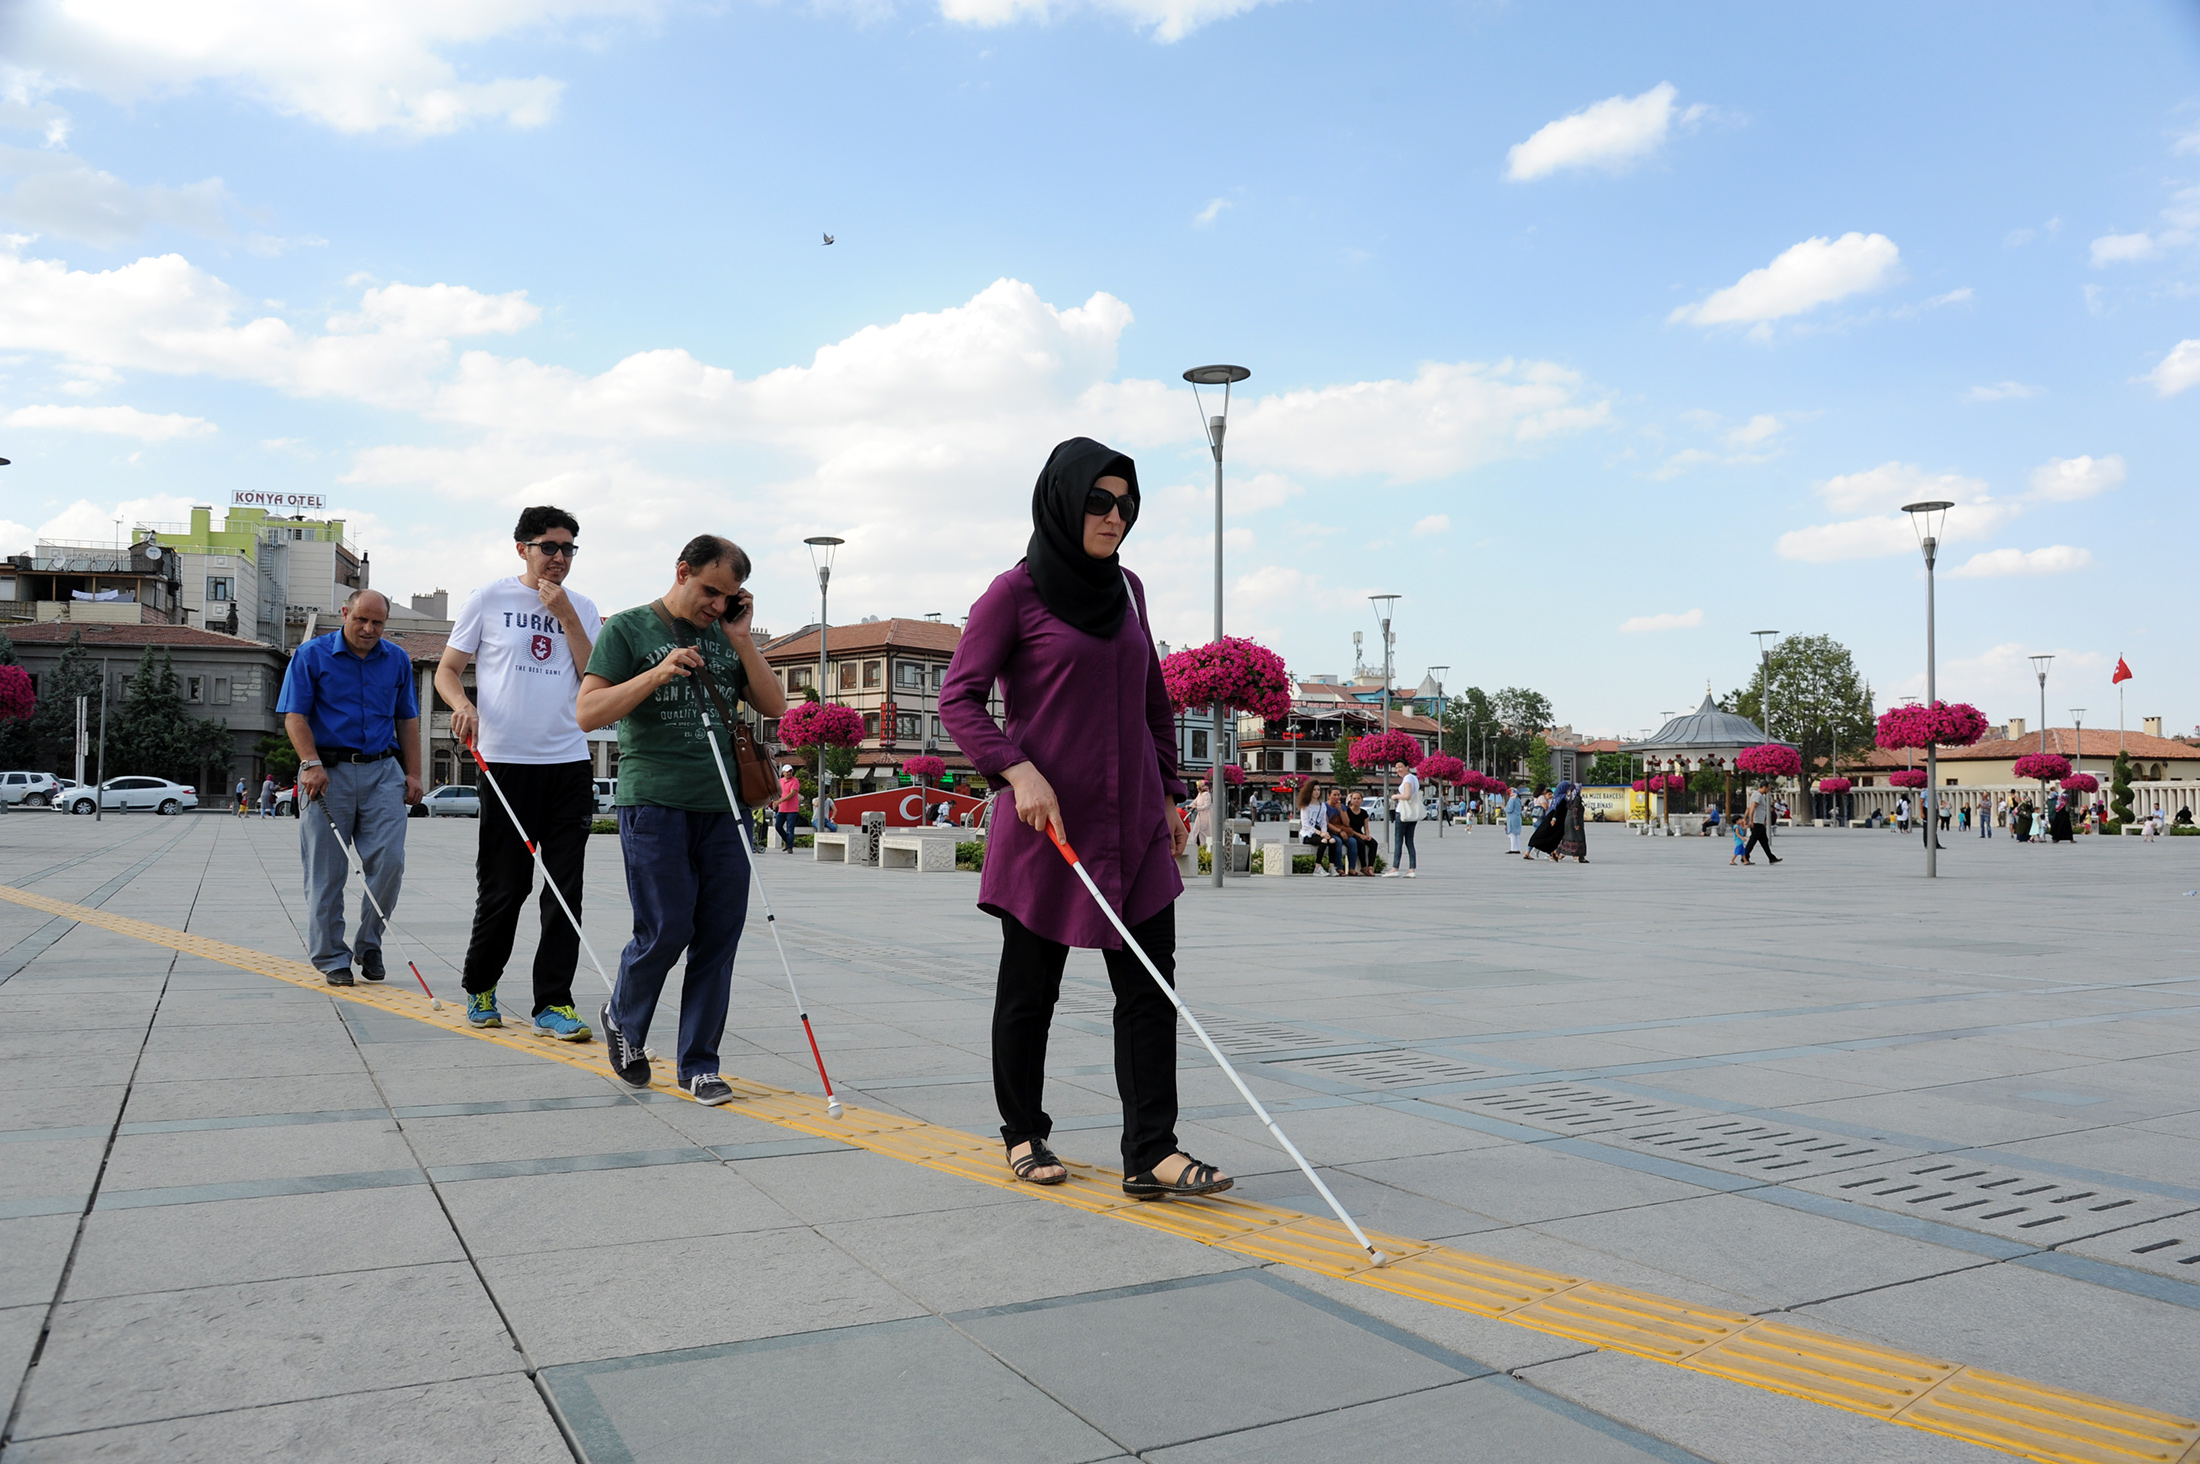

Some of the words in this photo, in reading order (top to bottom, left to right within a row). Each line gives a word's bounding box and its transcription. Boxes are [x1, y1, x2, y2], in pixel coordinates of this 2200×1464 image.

[235, 492, 283, 504] KONYA
[287, 495, 322, 506] OTEL
[503, 612, 565, 634] TURK
[655, 686, 679, 702] SAN
[660, 708, 698, 720] QUALITY
